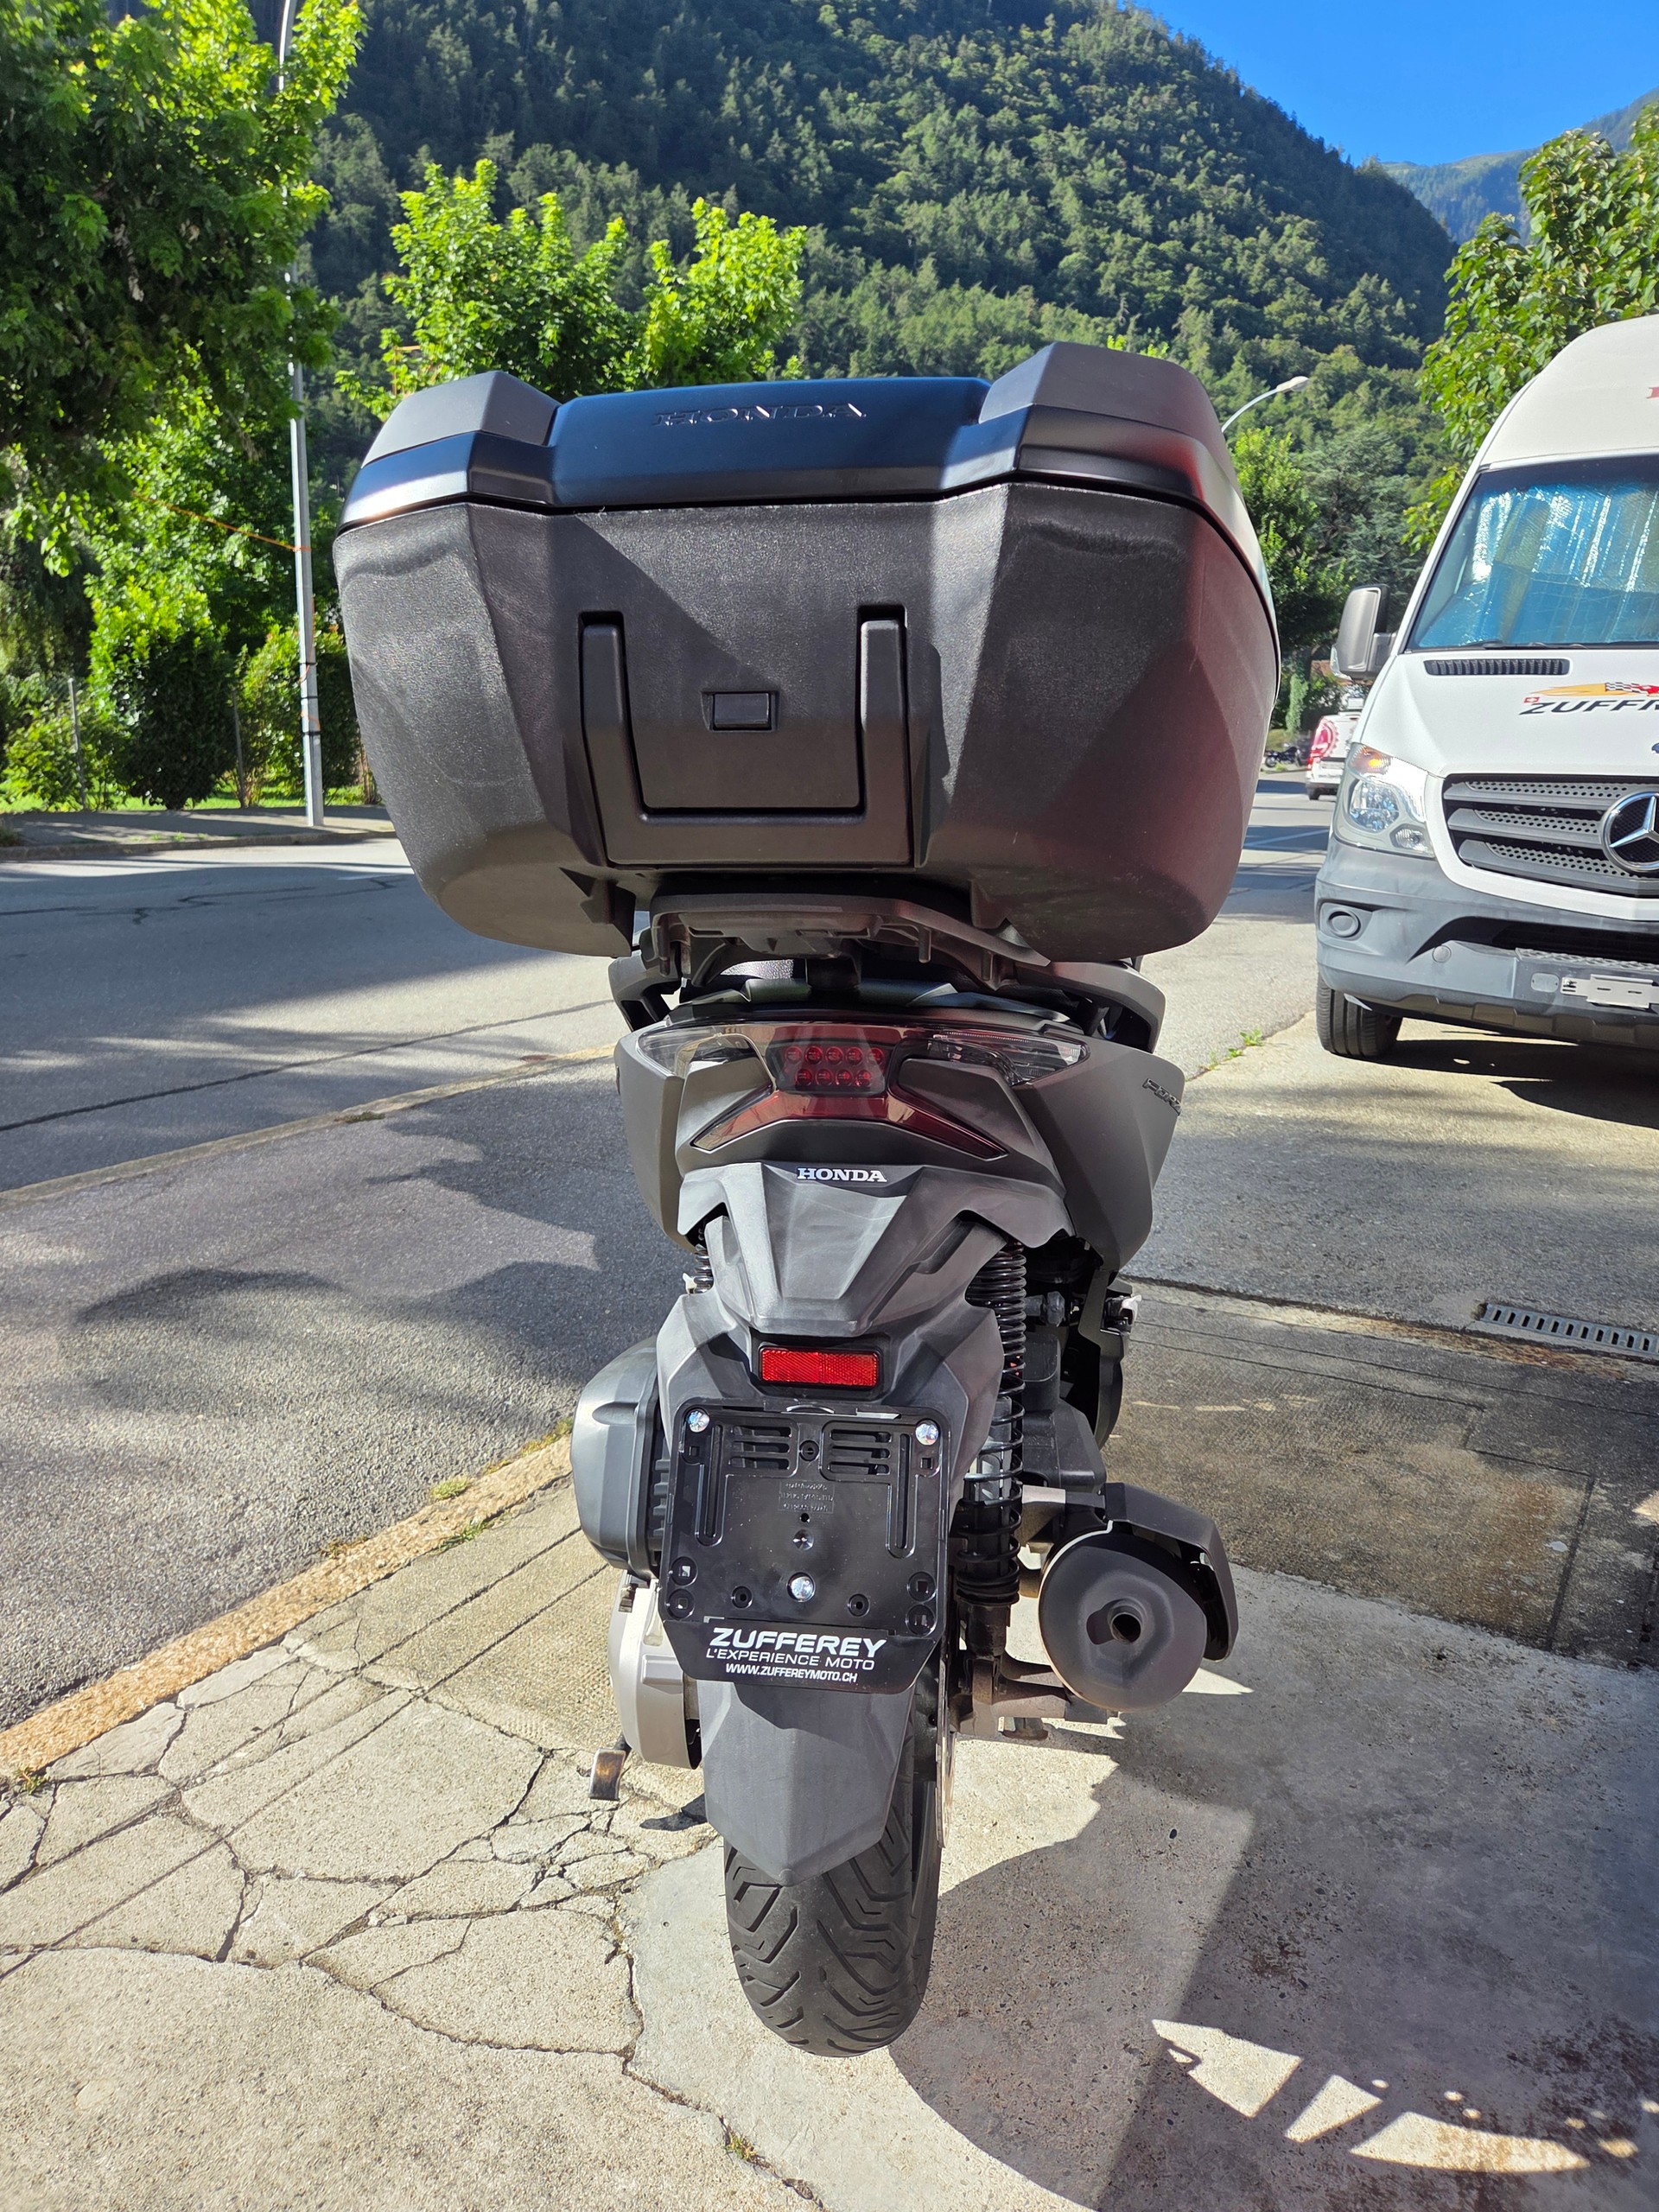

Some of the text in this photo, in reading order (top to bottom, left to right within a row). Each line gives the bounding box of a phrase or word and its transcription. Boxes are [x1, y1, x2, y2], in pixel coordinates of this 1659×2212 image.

[652, 403, 867, 426] HONDA
[798, 1167, 887, 1182] HONDA
[709, 1627, 887, 1658] ZUFFEREY
[705, 1648, 874, 1670] L'EXPERIENCE MOTO
[726, 1663, 858, 1683] WWW.ZUFFEREYMOTO.CH
